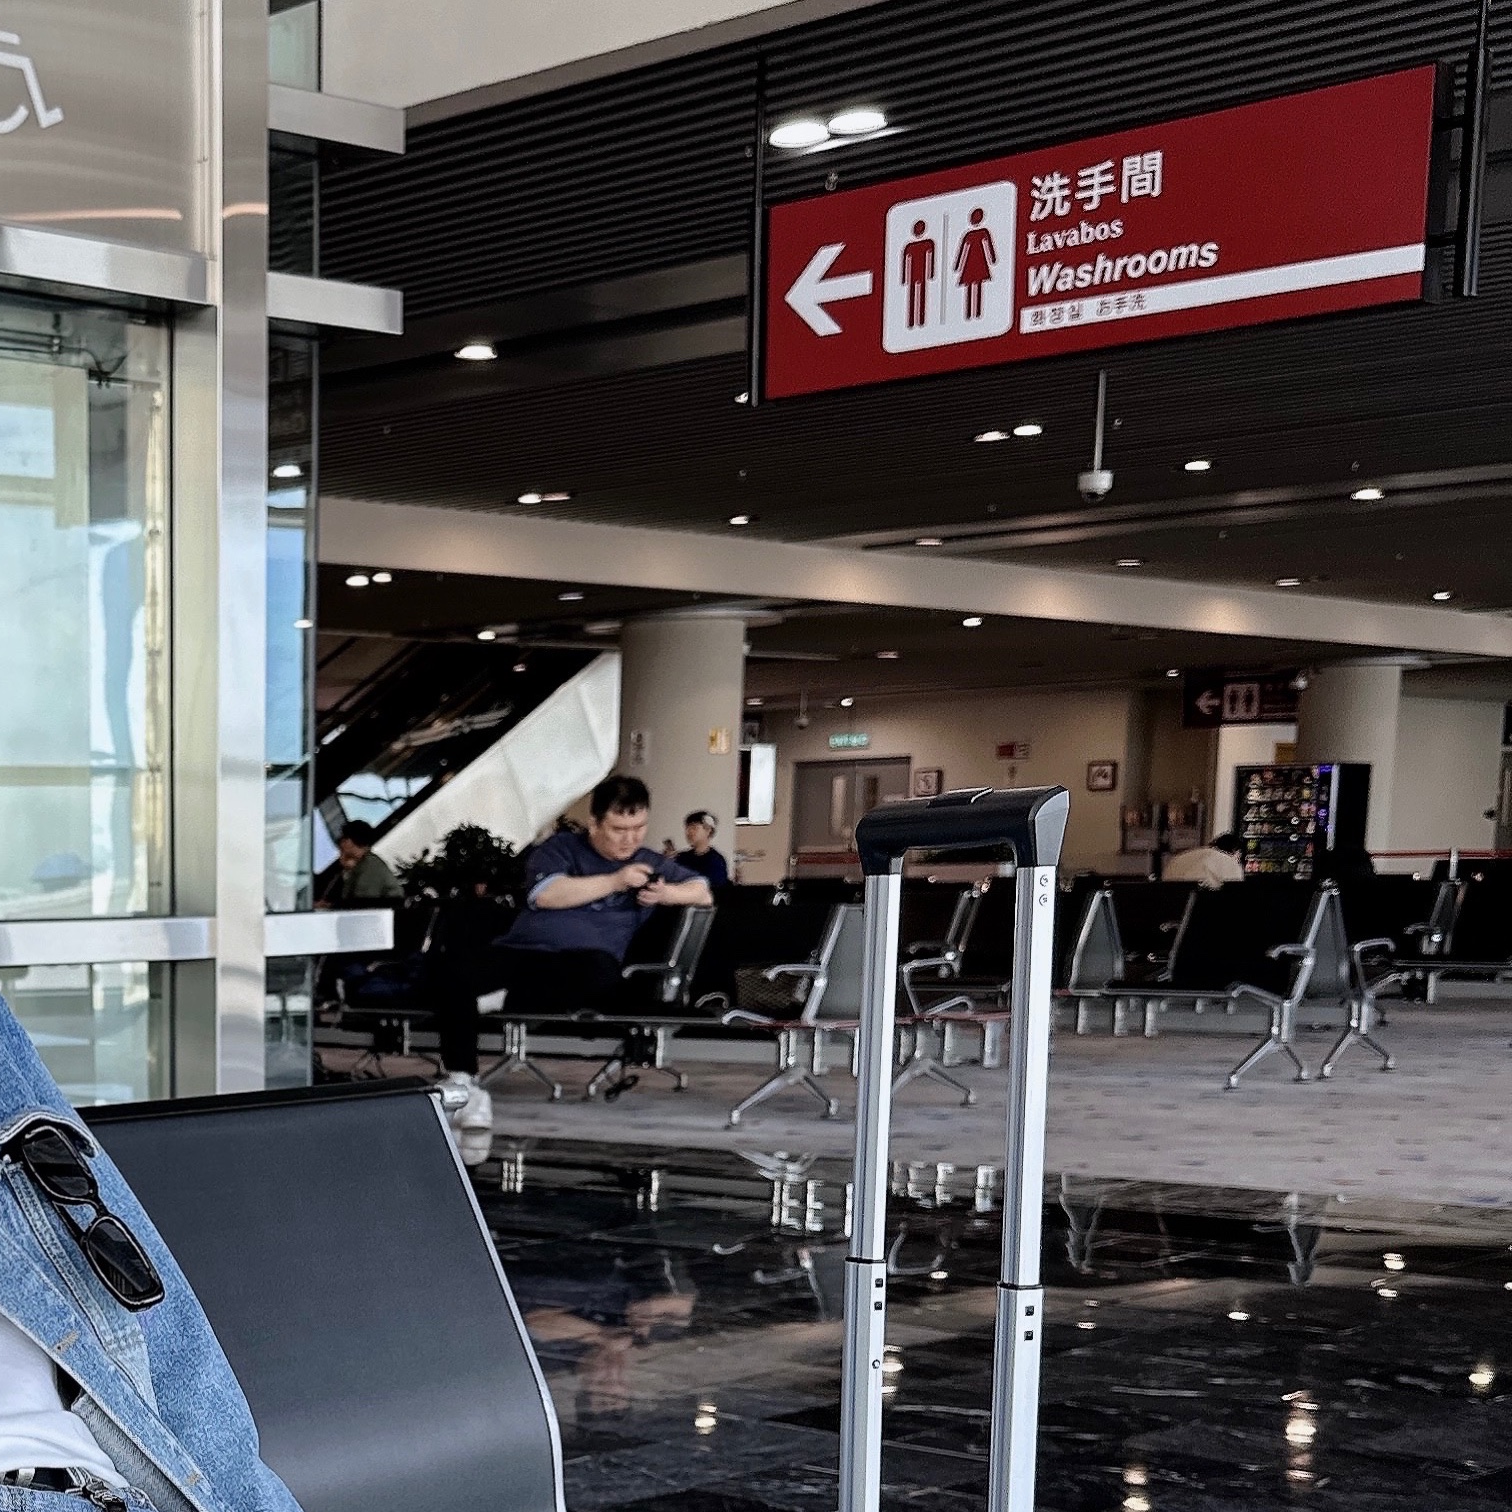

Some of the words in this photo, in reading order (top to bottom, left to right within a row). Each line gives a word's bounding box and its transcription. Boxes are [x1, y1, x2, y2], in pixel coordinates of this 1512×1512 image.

[1029, 150, 1164, 222] 洗手間
[1026, 219, 1124, 255] Lavabos
[1028, 242, 1219, 297] Washrooms
